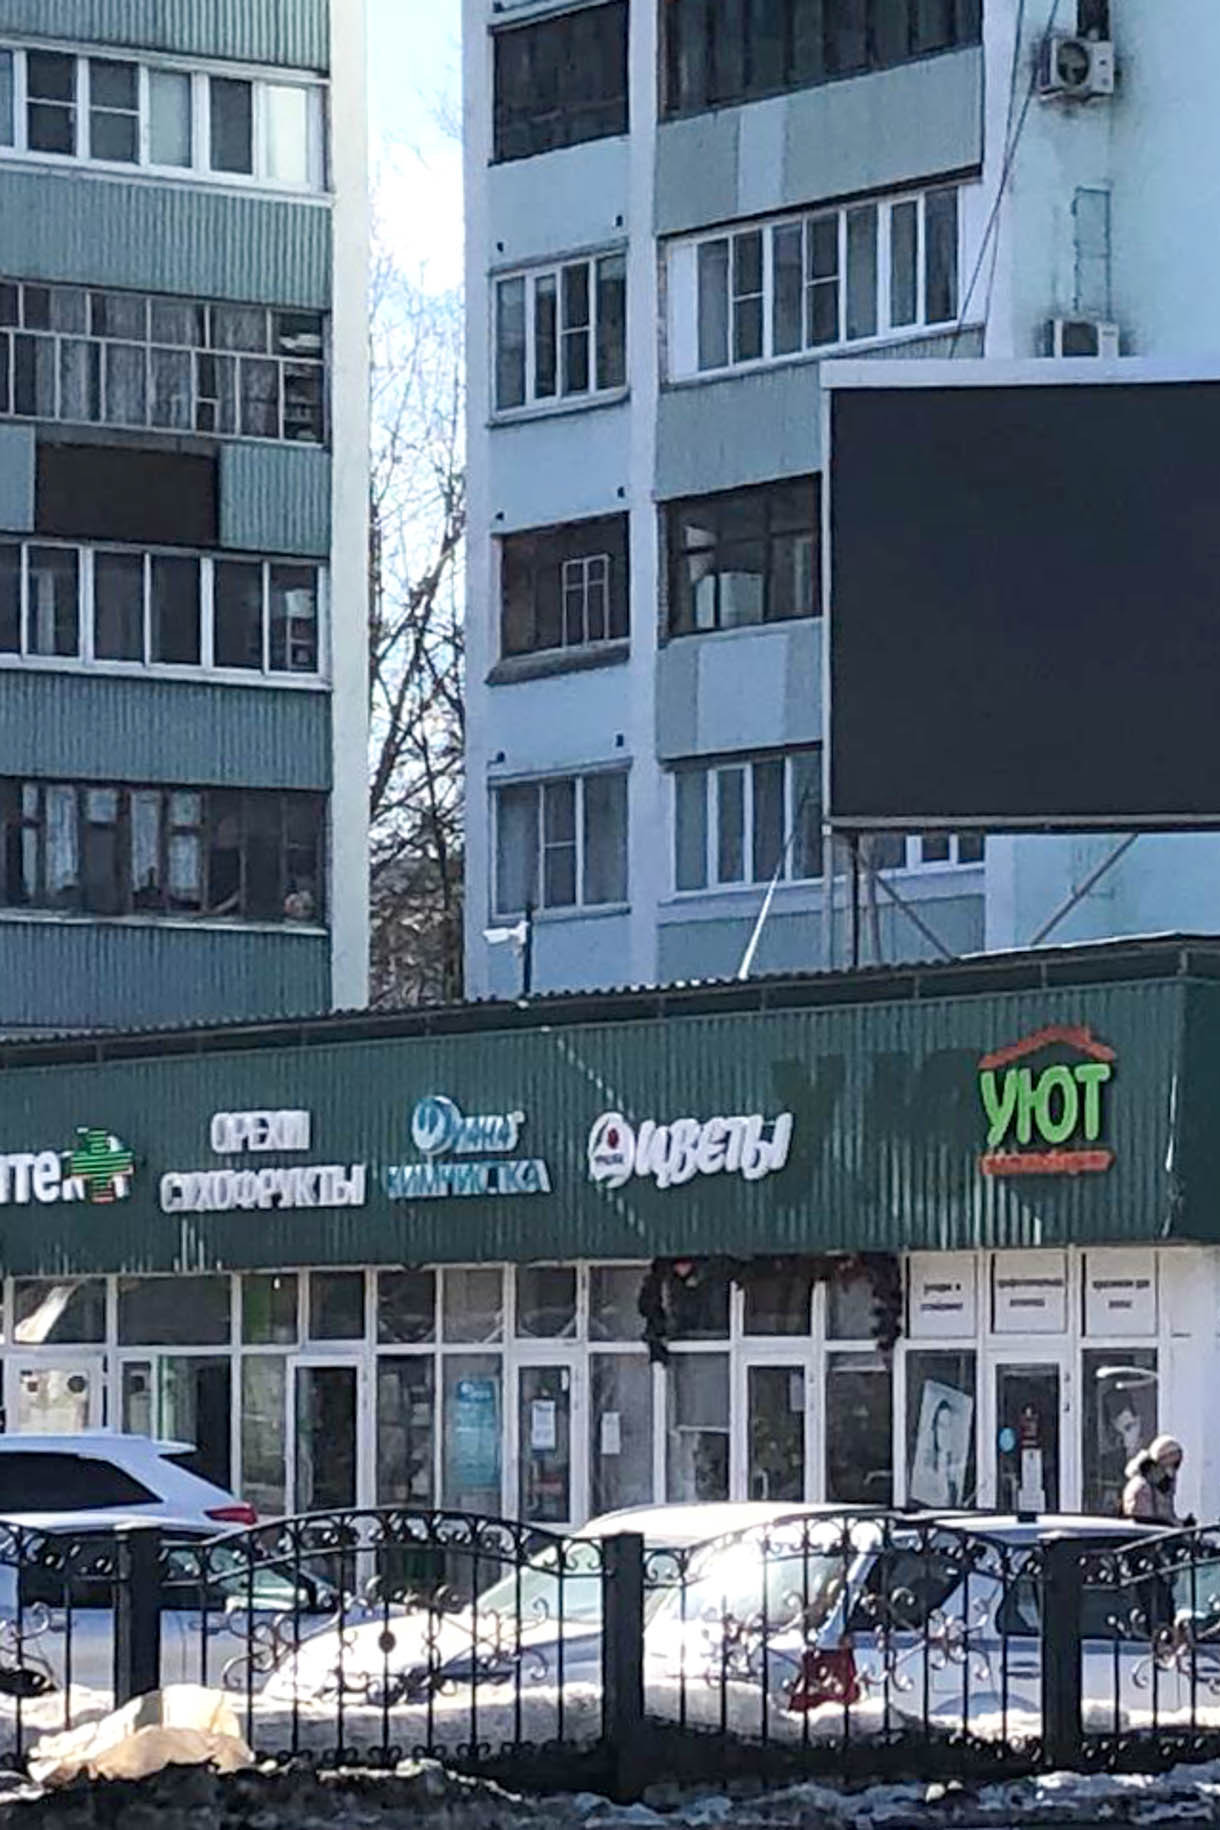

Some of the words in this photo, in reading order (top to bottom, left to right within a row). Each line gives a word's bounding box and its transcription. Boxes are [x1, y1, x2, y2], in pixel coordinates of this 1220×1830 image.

[980, 1065, 1112, 1146] УЮТ
[210, 1110, 311, 1154] ОРЕХИ
[160, 1163, 367, 1214] СУХОФРУКТЫ
